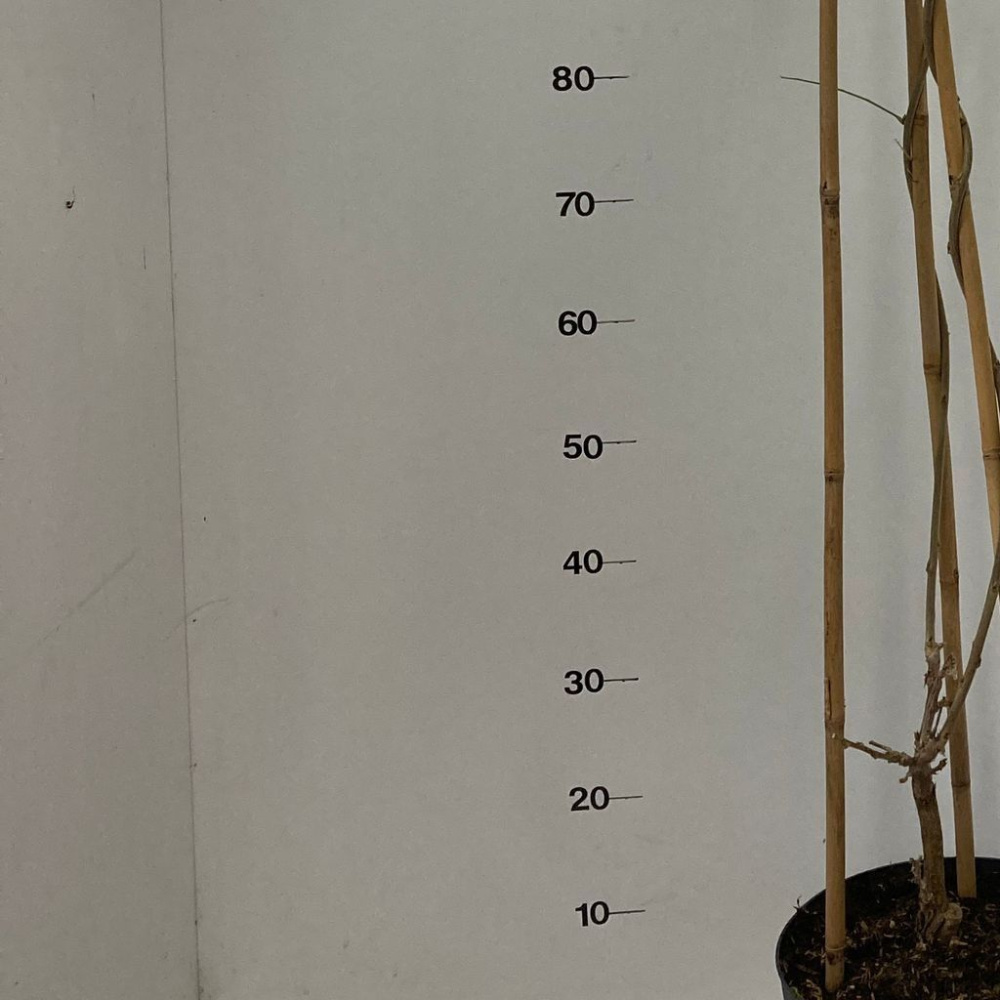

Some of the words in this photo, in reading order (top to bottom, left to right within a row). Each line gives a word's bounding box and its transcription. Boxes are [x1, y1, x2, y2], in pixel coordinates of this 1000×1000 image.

[552, 65, 595, 92] 80
[555, 191, 596, 217] 70
[557, 309, 598, 337] 60
[562, 433, 604, 460] 50
[562, 548, 604, 575] 40
[564, 668, 605, 695] 30
[568, 785, 610, 812] 20
[574, 900, 610, 927] 10
